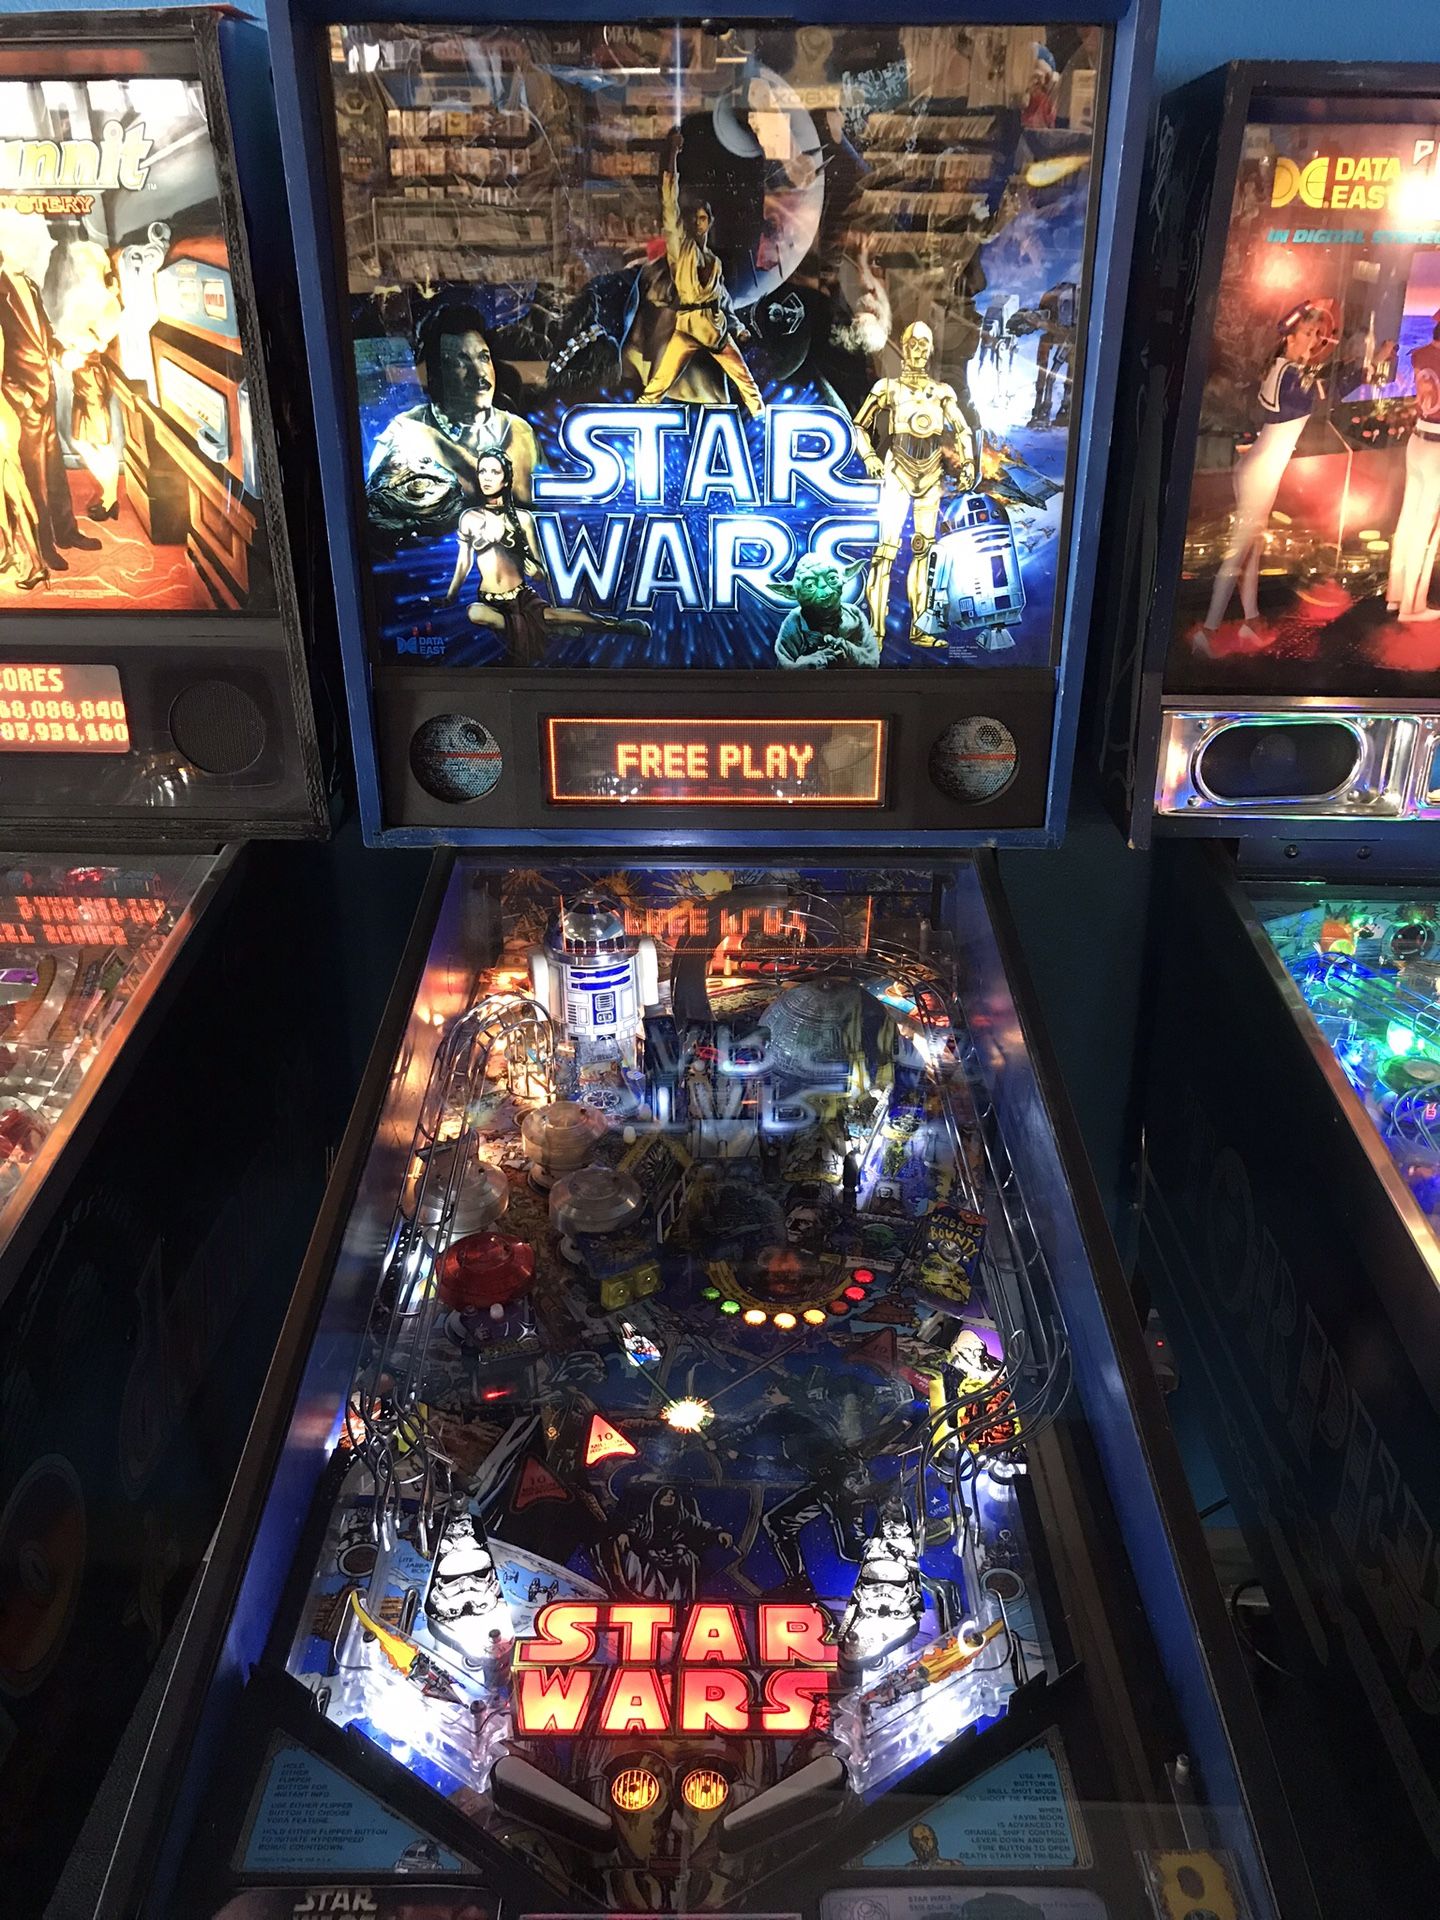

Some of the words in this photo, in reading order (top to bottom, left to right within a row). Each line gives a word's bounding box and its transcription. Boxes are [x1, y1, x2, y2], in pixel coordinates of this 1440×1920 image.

[1335, 157, 1401, 181] DATA
[1266, 228, 1290, 243] IN
[1292, 228, 1365, 243] DIGITAL
[531, 403, 885, 507] STAR
[533, 510, 884, 613] WARS
[418, 636, 444, 646] DATA
[419, 646, 446, 655] EAST
[616, 744, 709, 779] FREE
[719, 744, 814, 779] PLAY
[930, 1225, 980, 1257] BOUNTY
[597, 1432, 613, 1442] 10
[929, 1503, 951, 1517] SPOT
[513, 1600, 839, 1670] STAR
[511, 1665, 832, 1737] WARS
[293, 1887, 378, 1912] STAR
